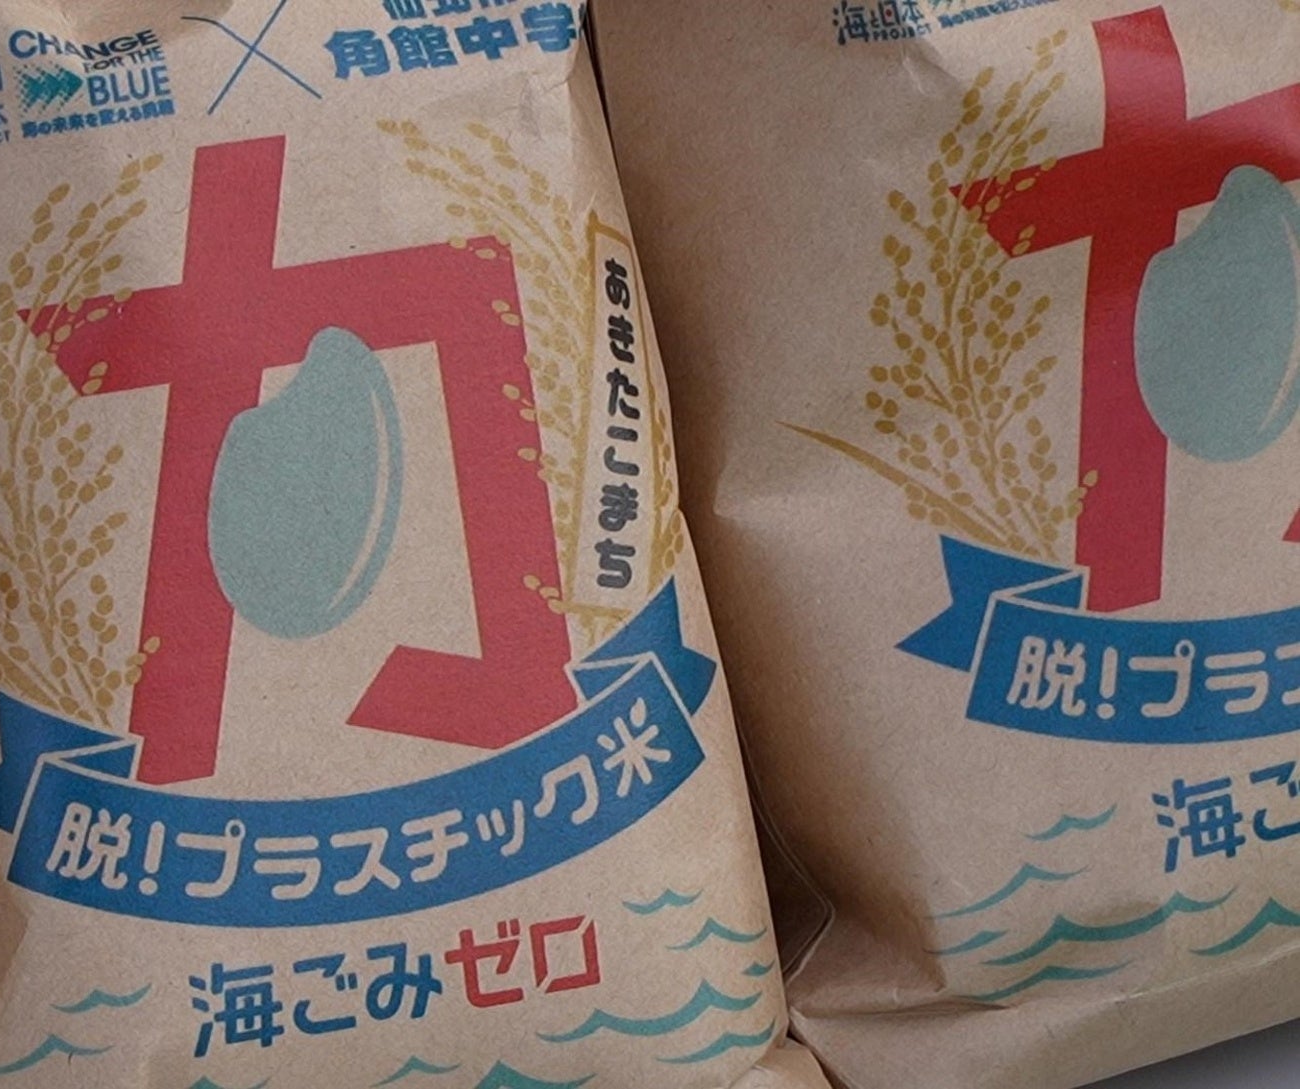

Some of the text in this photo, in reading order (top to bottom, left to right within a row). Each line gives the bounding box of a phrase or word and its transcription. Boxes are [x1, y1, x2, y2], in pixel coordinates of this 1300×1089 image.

[8, 28, 159, 61] CHANGE
[83, 46, 166, 74] FOR THE
[324, 2, 585, 79] 角館中学
[86, 66, 173, 107] BLUE
[595, 258, 641, 590] あきたこまち
[46, 697, 671, 899] 脱!プラスチック米
[189, 914, 601, 1059] 海ごみゼロ
